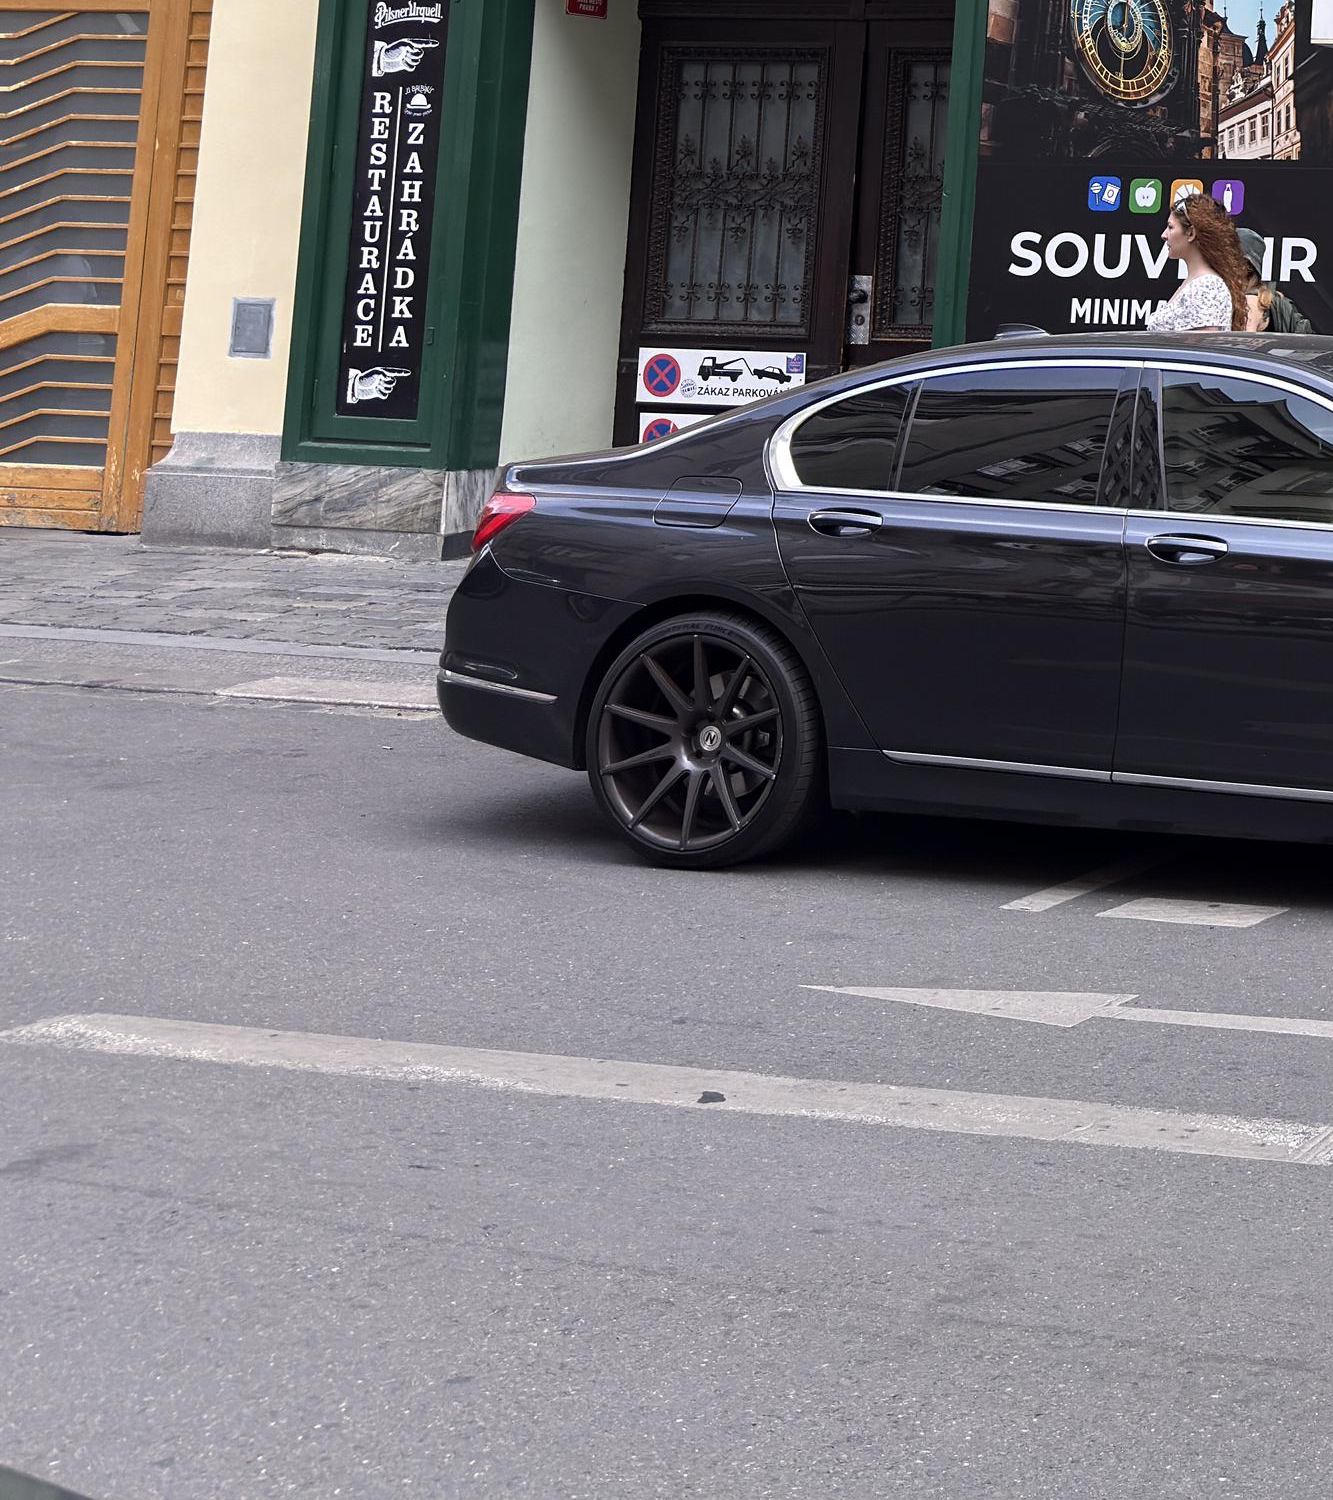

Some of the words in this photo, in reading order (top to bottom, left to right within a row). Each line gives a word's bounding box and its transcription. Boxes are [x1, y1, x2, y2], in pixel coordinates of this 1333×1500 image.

[374, 1, 409, 29] Pilsner
[408, 0, 442, 23] Urquell
[353, 91, 393, 347] RESTAURACE
[389, 123, 425, 347] ZAHRÁDKA
[1008, 231, 1317, 282] SOUVIR
[697, 384, 730, 397] ZÁKAZ
[732, 386, 786, 398] PARKOVÁ
